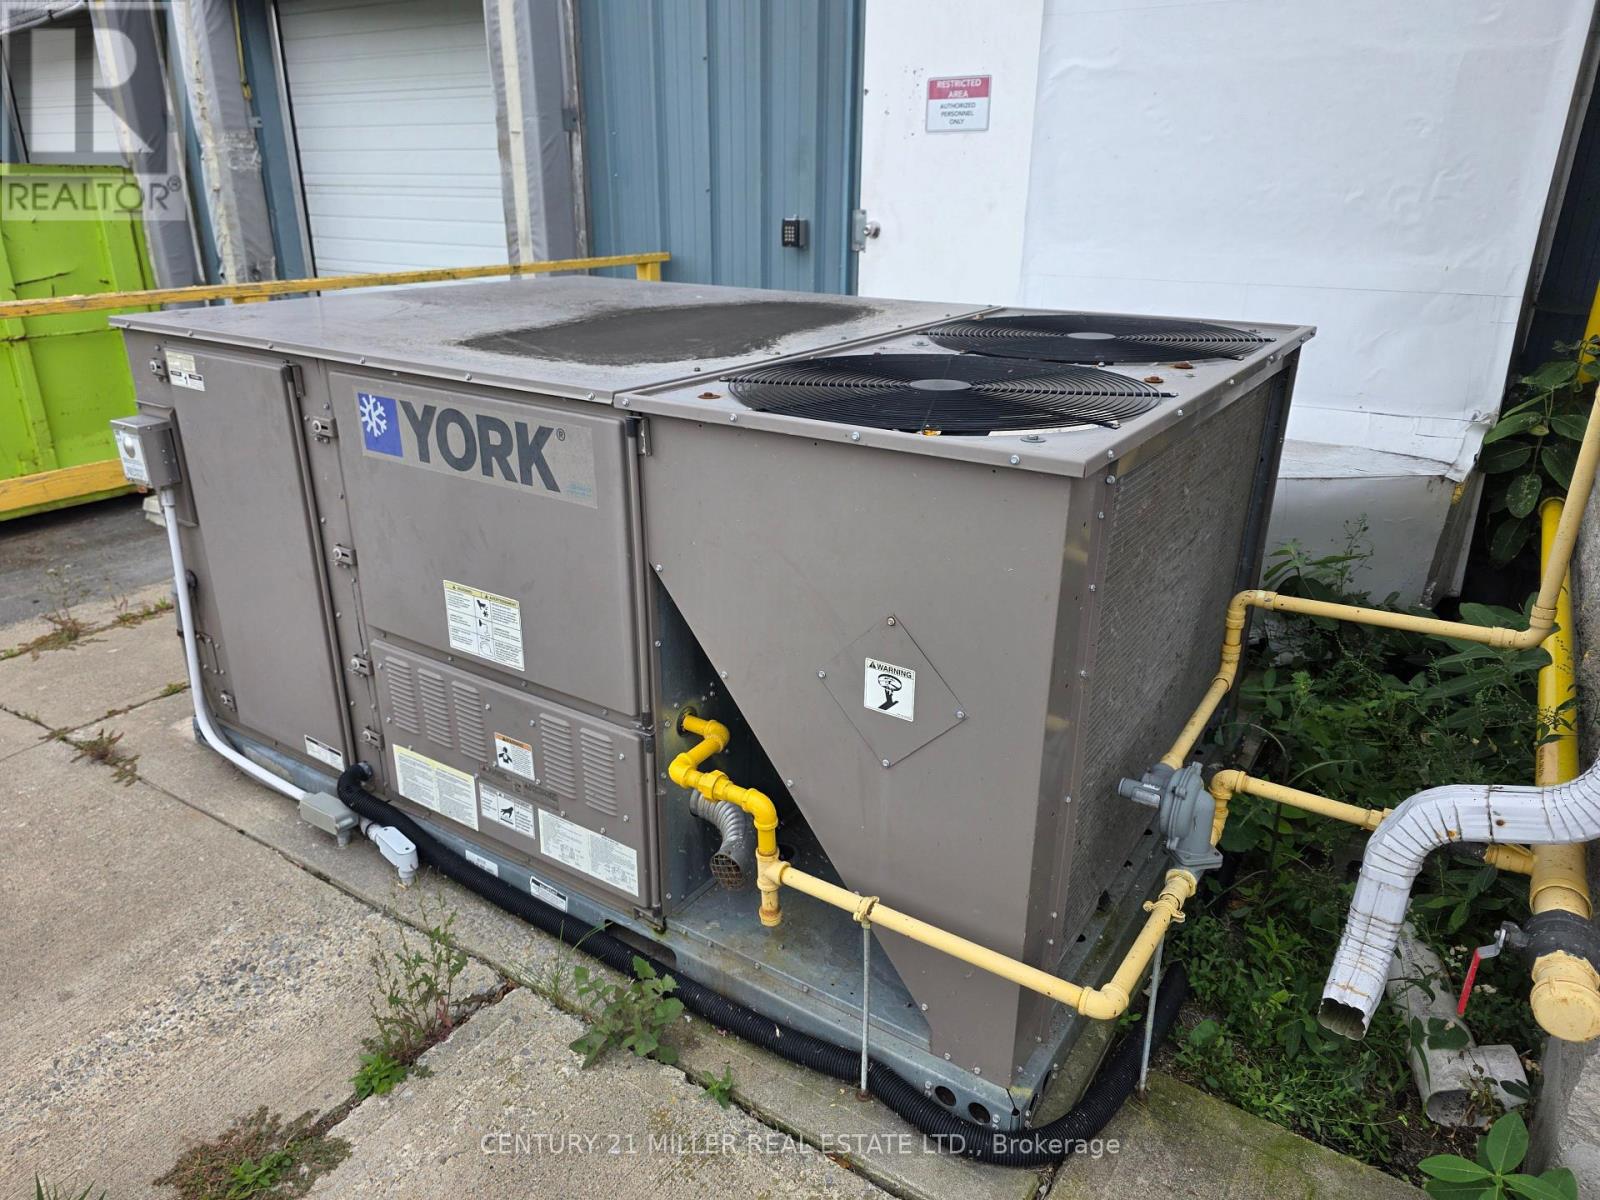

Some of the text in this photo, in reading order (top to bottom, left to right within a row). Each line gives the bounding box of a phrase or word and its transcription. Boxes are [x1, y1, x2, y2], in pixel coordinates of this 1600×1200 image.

[936, 79, 982, 88] RESTRICTED
[948, 90, 969, 98] AREA
[876, 663, 912, 679] WARNING
